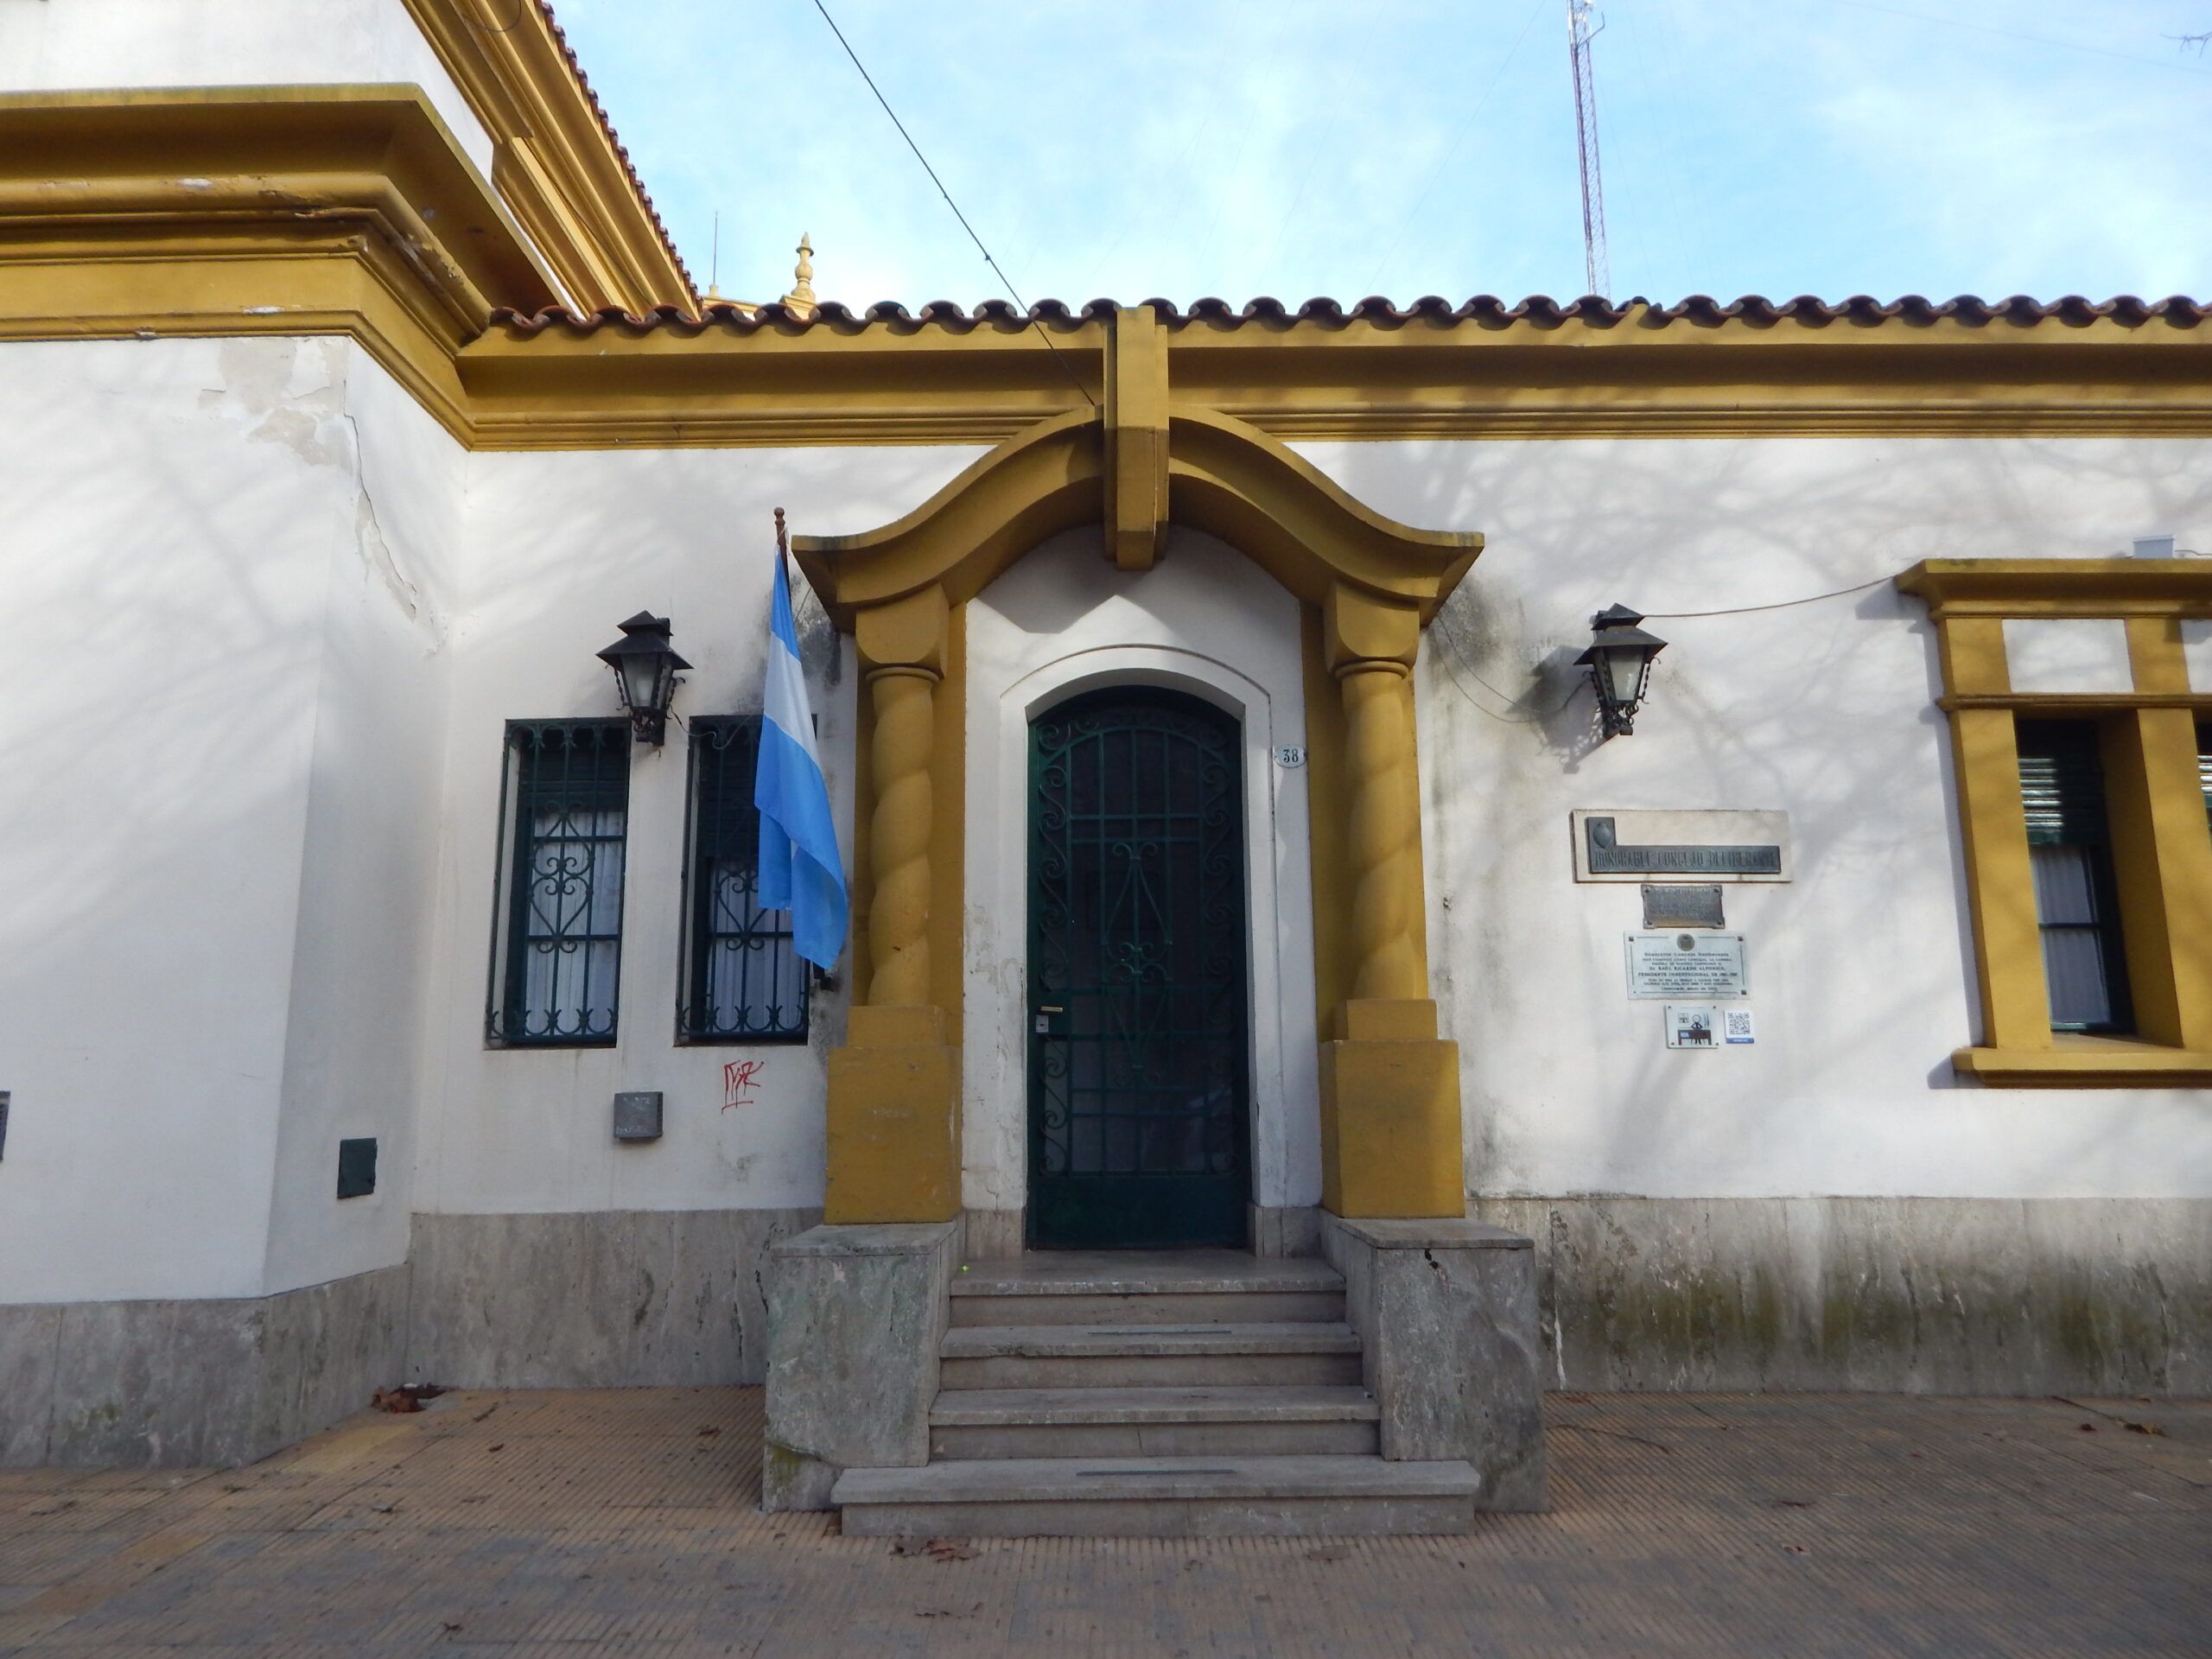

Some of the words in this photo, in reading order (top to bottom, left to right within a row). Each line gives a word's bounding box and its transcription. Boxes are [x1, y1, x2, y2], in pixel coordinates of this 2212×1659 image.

[1283, 748, 1299, 763] 38
[1595, 850, 1649, 867] HONORABLE
[1657, 850, 1703, 867] CONCEJO
[1708, 850, 1775, 867] DELIBERANTE
